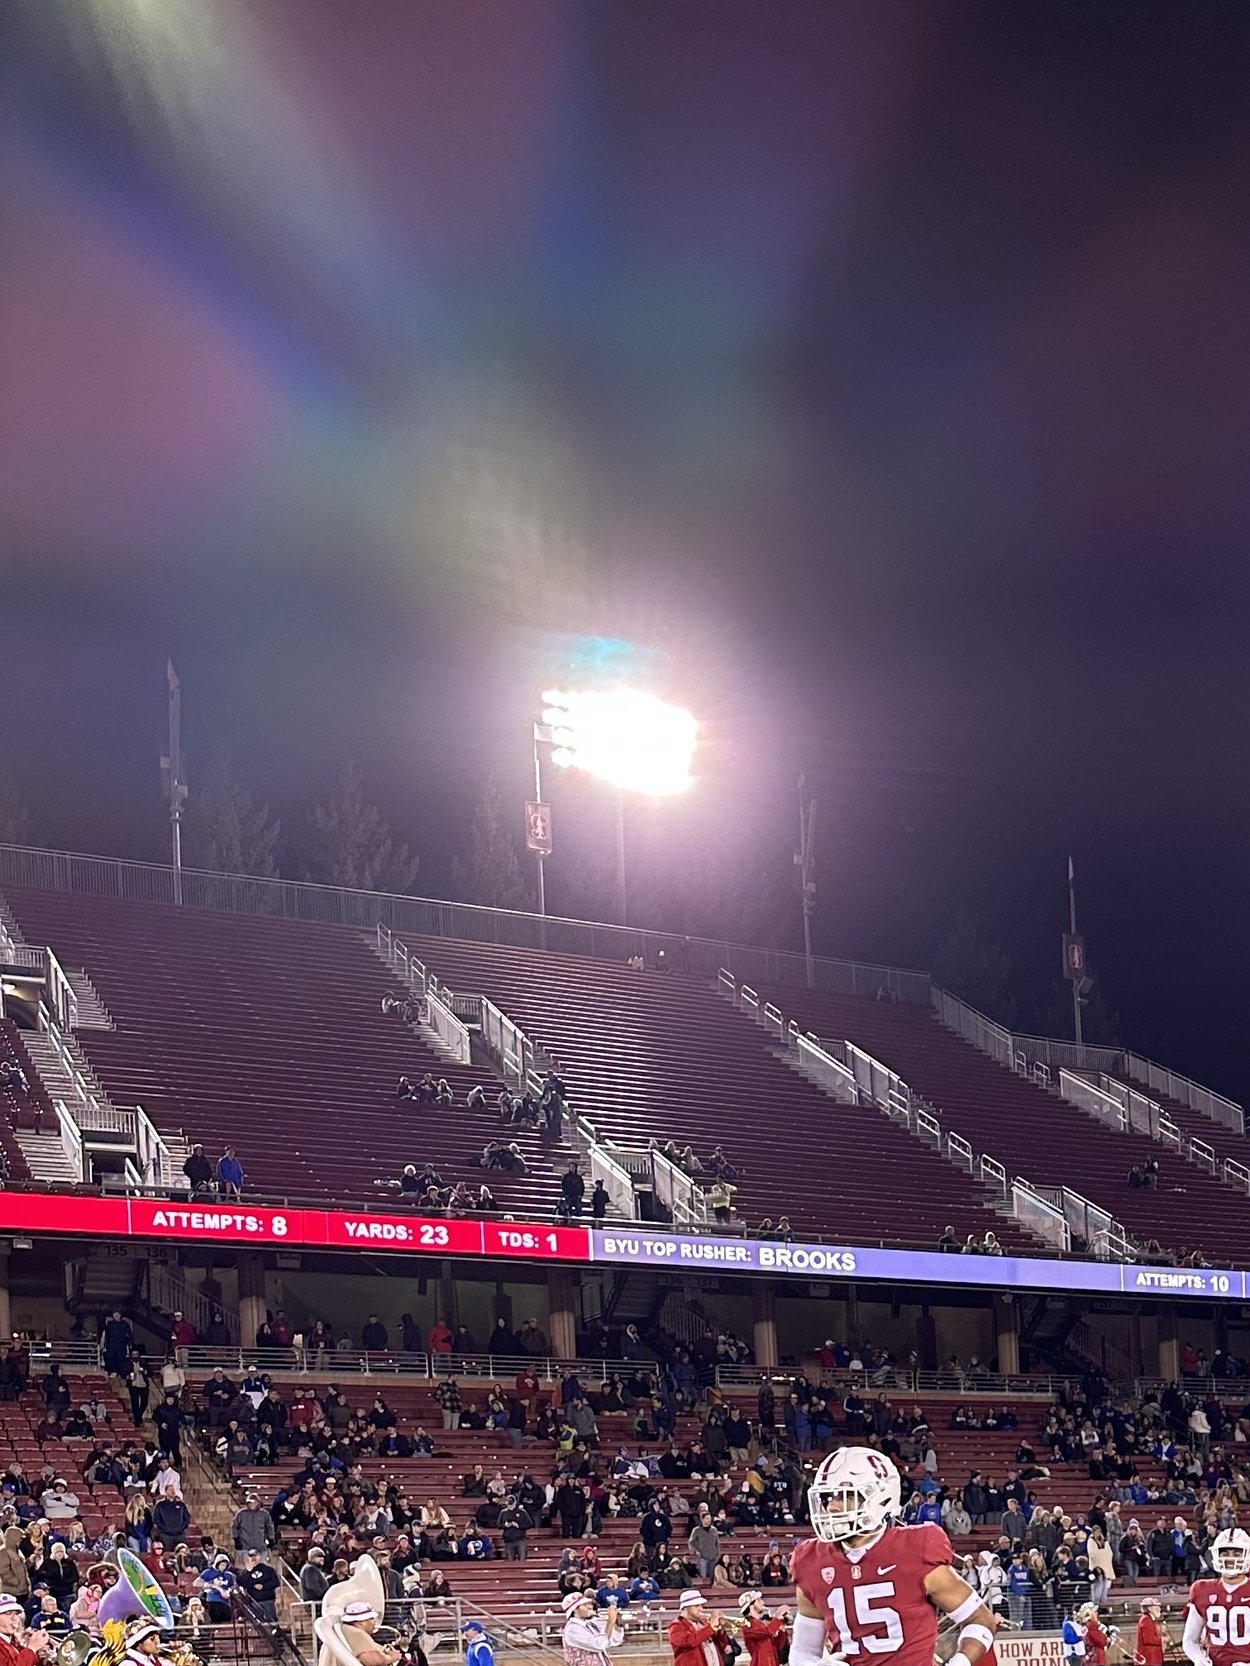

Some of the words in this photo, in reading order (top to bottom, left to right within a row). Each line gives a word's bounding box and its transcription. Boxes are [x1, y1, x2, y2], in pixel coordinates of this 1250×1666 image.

[152, 1210, 265, 1232] ATTEMPTS:
[271, 1216, 287, 1236] 8
[344, 1221, 414, 1240] YARDS:
[419, 1224, 449, 1245] 23
[498, 1231, 539, 1248] TDS:
[546, 1233, 558, 1252] 1
[604, 1238, 640, 1255] BYU
[642, 1240, 677, 1258] TOP
[680, 1242, 752, 1262] RUSHER:
[758, 1247, 856, 1271] BROOKS
[1136, 1272, 1206, 1290] ATTEMPTS:
[1210, 1275, 1230, 1293] 10
[827, 1581, 904, 1655] 15
[999, 1642, 1033, 1658] HOW
